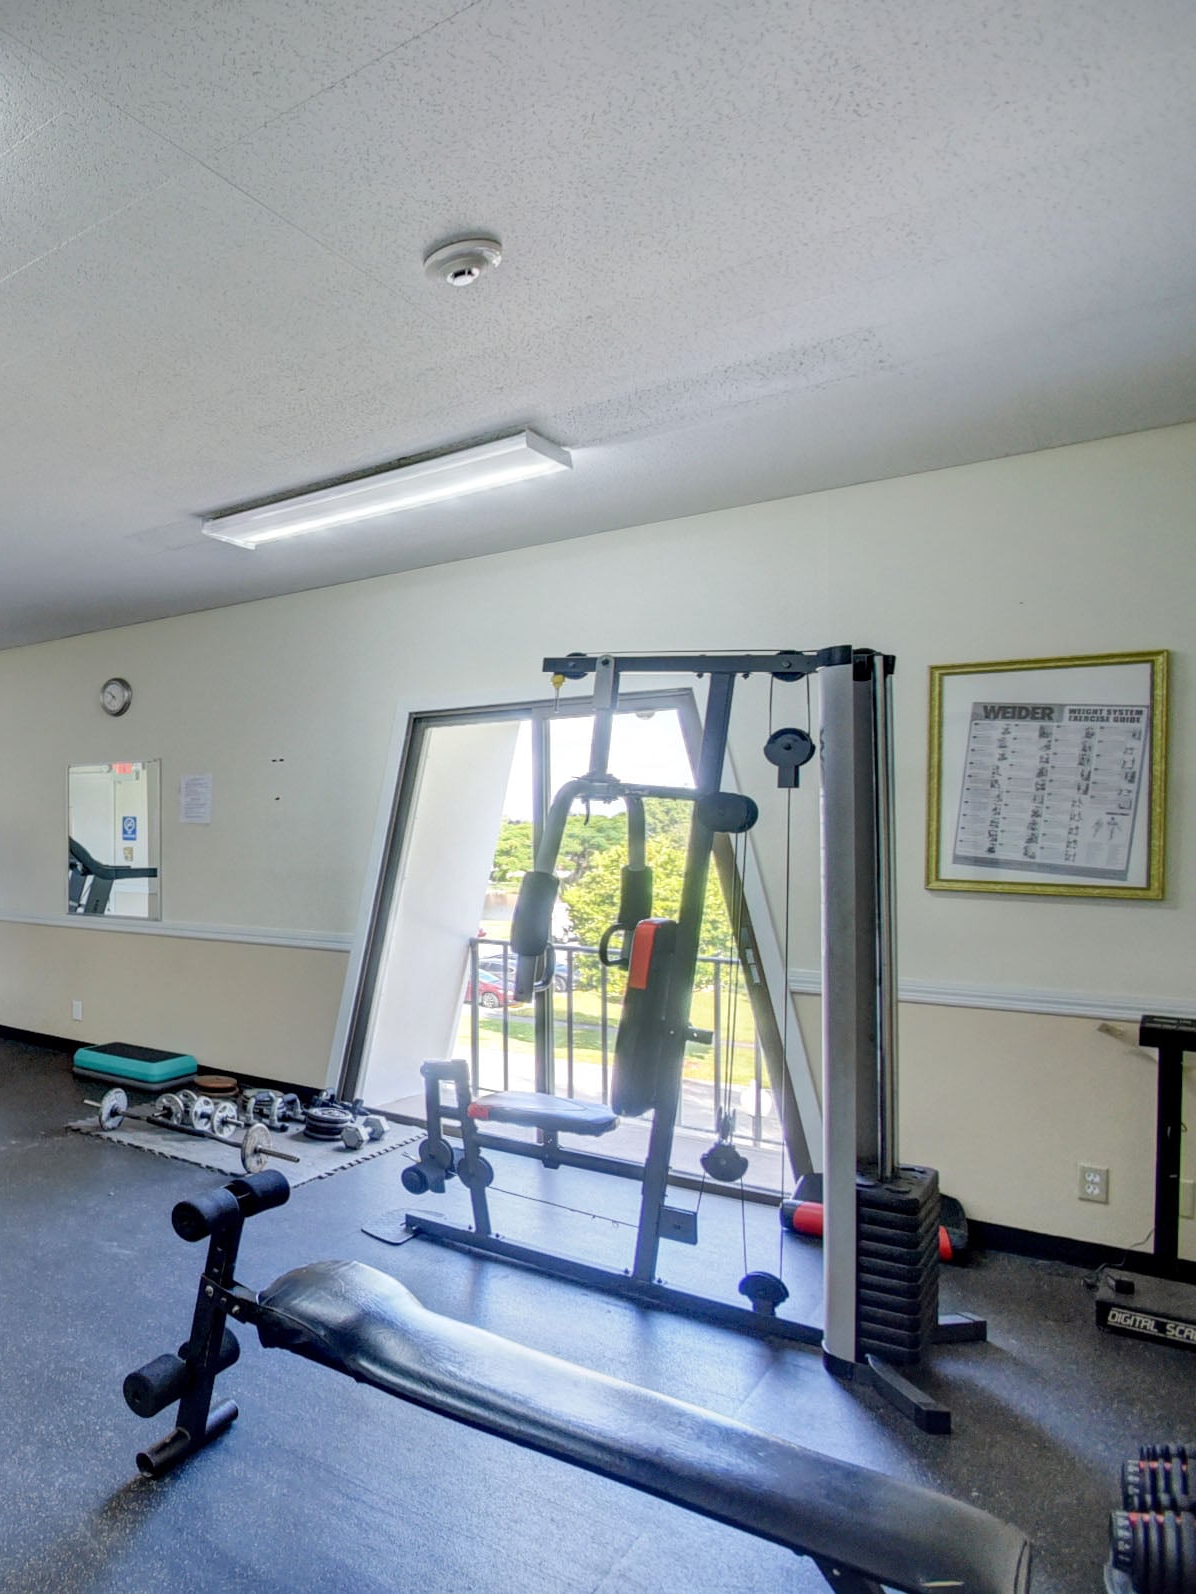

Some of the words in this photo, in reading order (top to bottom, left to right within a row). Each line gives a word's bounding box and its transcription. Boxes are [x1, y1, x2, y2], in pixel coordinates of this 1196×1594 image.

[983, 705, 1054, 721] WEIDER
[1068, 708, 1104, 716] WEIGHT
[1106, 708, 1144, 716] SYSTEM
[1068, 715, 1111, 723] EXERCISE
[1113, 716, 1142, 724] GUIDE
[1107, 1311, 1158, 1332] DIGITAL
